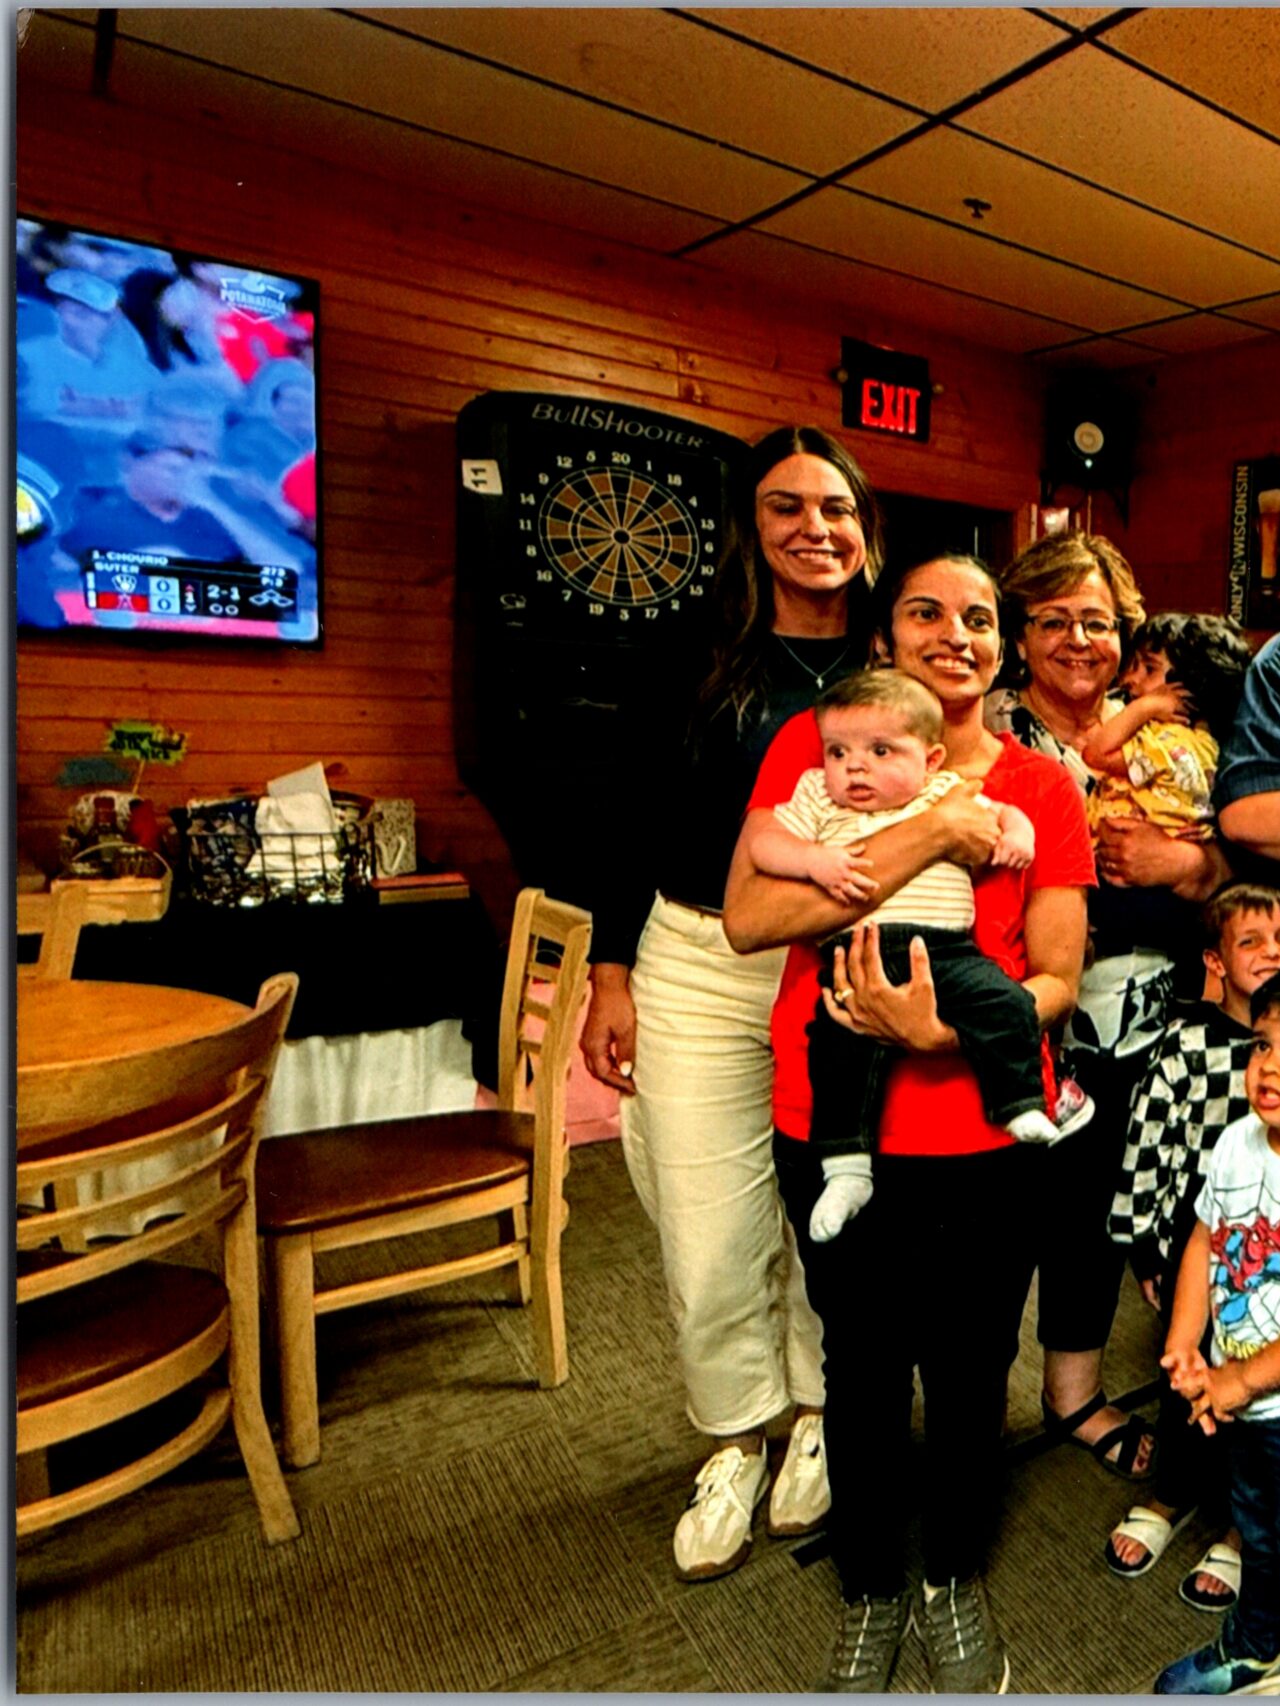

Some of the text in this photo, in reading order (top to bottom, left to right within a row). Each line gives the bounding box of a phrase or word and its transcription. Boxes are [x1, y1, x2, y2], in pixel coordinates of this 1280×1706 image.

[862, 378, 921, 434] EXIT
[556, 455, 573, 468] 12
[611, 451, 631, 464] 20
[646, 460, 652, 471] 1
[470, 467, 488, 488] 11
[538, 473, 549, 485] 9
[520, 493, 535, 505] 14
[688, 496, 698, 507] 4
[1233, 465, 1249, 559] WISCONSIN
[519, 519, 532, 530] 11
[704, 542, 714, 553] 6
[536, 570, 552, 582] 16
[701, 564, 714, 576] 10
[156, 577, 170, 593] 0
[562, 590, 572, 601] 7
[1230, 582, 1243, 621] ONLY
[157, 594, 171, 611] 0
[671, 600, 680, 611] 2
[589, 603, 604, 615] 19
[645, 608, 659, 620] 17
